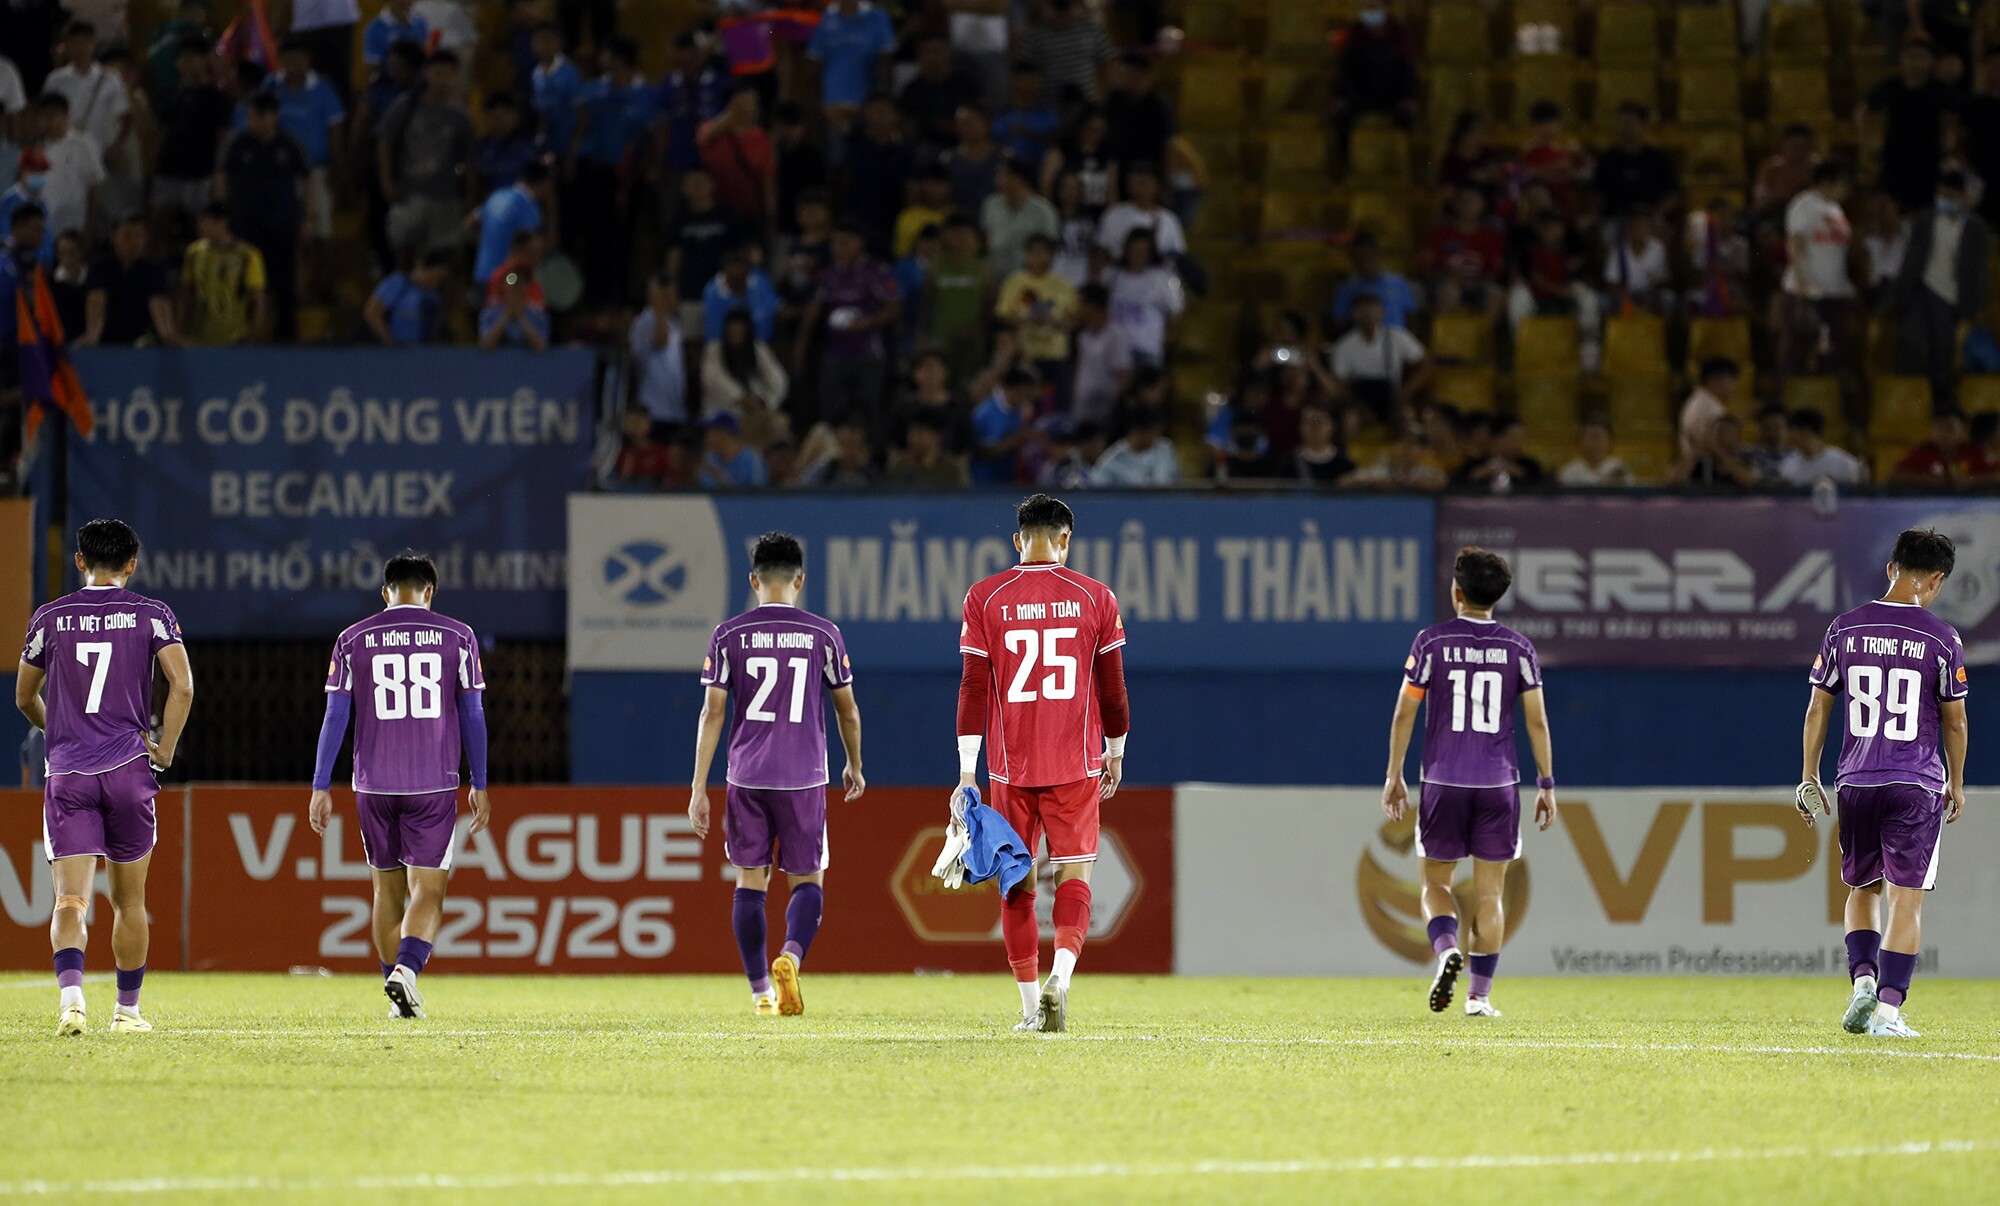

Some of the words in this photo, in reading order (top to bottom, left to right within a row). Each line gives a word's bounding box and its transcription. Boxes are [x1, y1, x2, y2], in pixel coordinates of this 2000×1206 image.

[87, 385, 182, 455] HỘI
[282, 385, 441, 456] ĐỘNG
[452, 386, 579, 445] VIÊN
[210, 471, 454, 518] BECAMEX
[1214, 518, 1420, 622] THÀNH
[1496, 548, 1837, 613] ERRA
[79, 614, 101, 634] VIỆT
[365, 633, 378, 648] M.
[415, 629, 443, 647] QUÂN
[740, 633, 749, 649] T.
[752, 630, 773, 648] ĐÌNH
[1001, 605, 1013, 621] T.
[1016, 603, 1046, 620] MINH
[1050, 599, 1081, 618] TOÀN
[76, 642, 112, 714] 7
[1004, 627, 1078, 703] 25
[1443, 646, 1452, 662] V.
[1846, 636, 1857, 653] N.
[1862, 636, 1898, 657] TRỌNG
[1901, 639, 1926, 660] PHÚ
[372, 652, 442, 720] 88
[745, 656, 808, 723] 21
[1447, 669, 1503, 734] 10
[1847, 665, 1922, 742] 89
[227, 813, 703, 881] V.LAGUE
[1559, 802, 1844, 925] VP
[318, 896, 676, 966] 225/26
[1551, 944, 1662, 974] Vietnam
[1666, 944, 1825, 974] Professional
